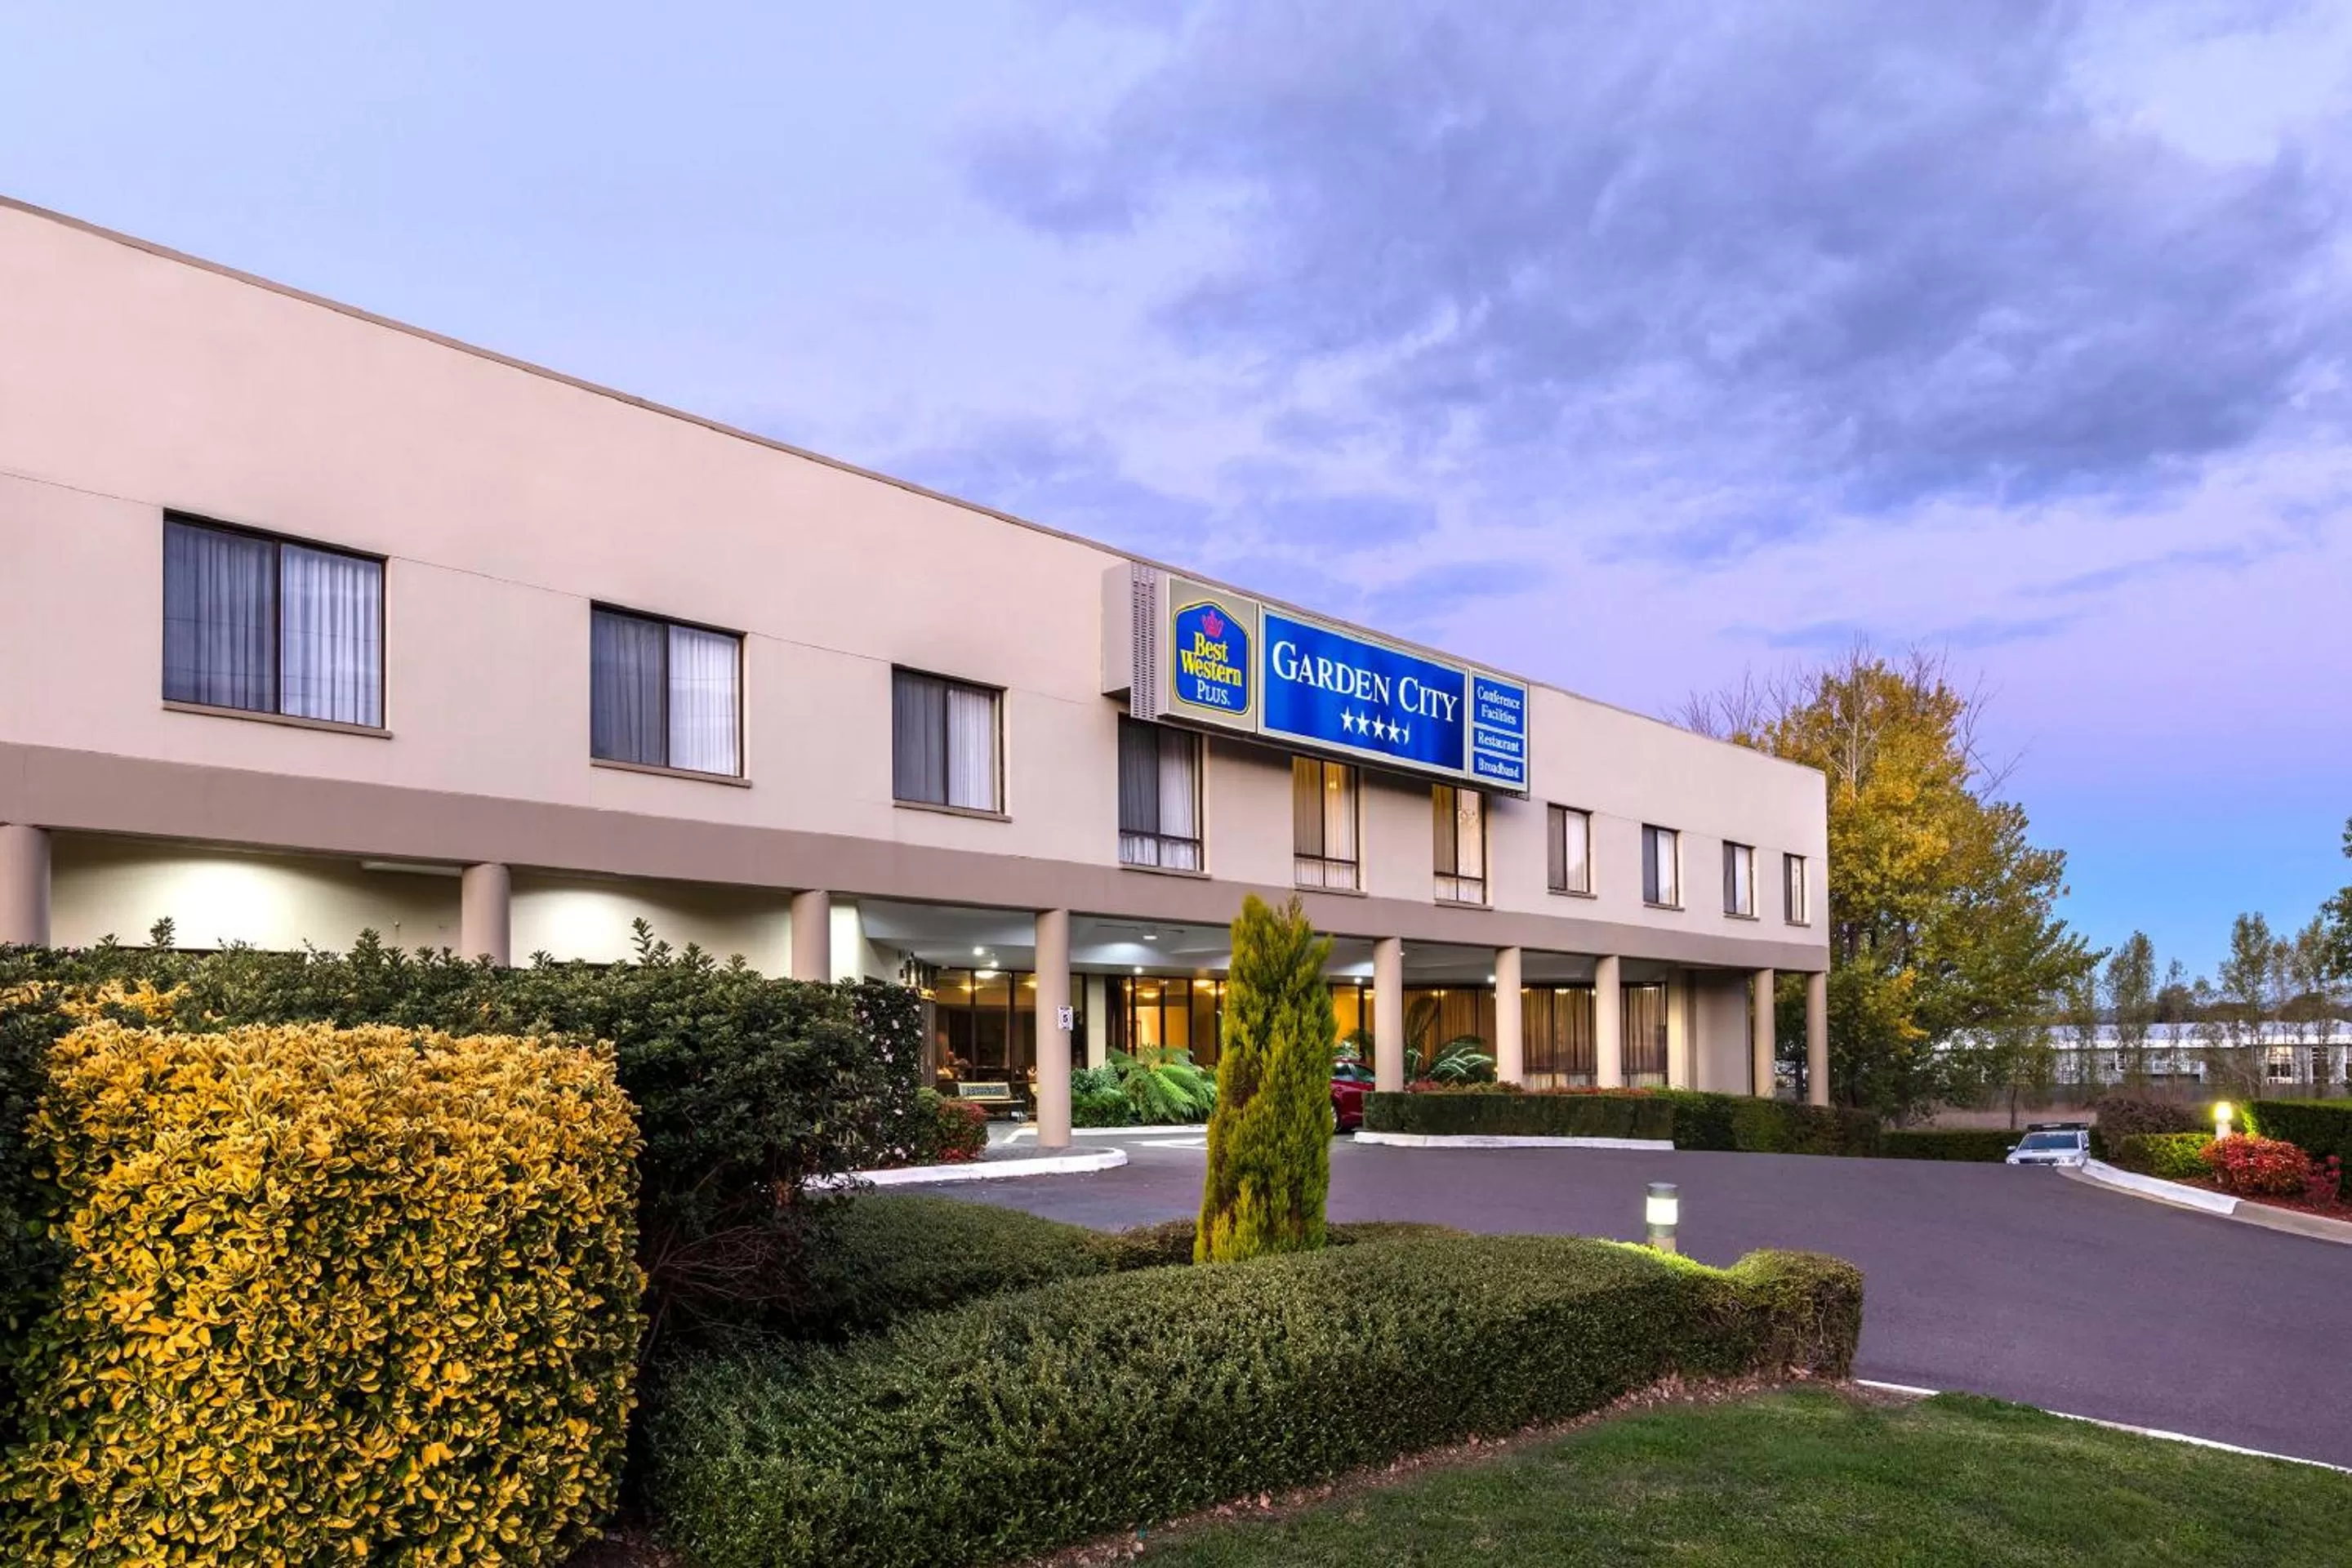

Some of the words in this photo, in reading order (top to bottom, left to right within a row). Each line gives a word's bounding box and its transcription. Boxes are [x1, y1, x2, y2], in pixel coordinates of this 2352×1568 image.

[1194, 630, 1228, 662] Best
[1180, 648, 1242, 687] Western
[1272, 640, 1391, 706] GARDEN
[1399, 676, 1459, 722] CITY
[1477, 686, 1521, 710] Conference
[1481, 704, 1517, 725] Facilities
[1477, 731, 1520, 752] Restaurant
[1477, 757, 1520, 778] Broadband
